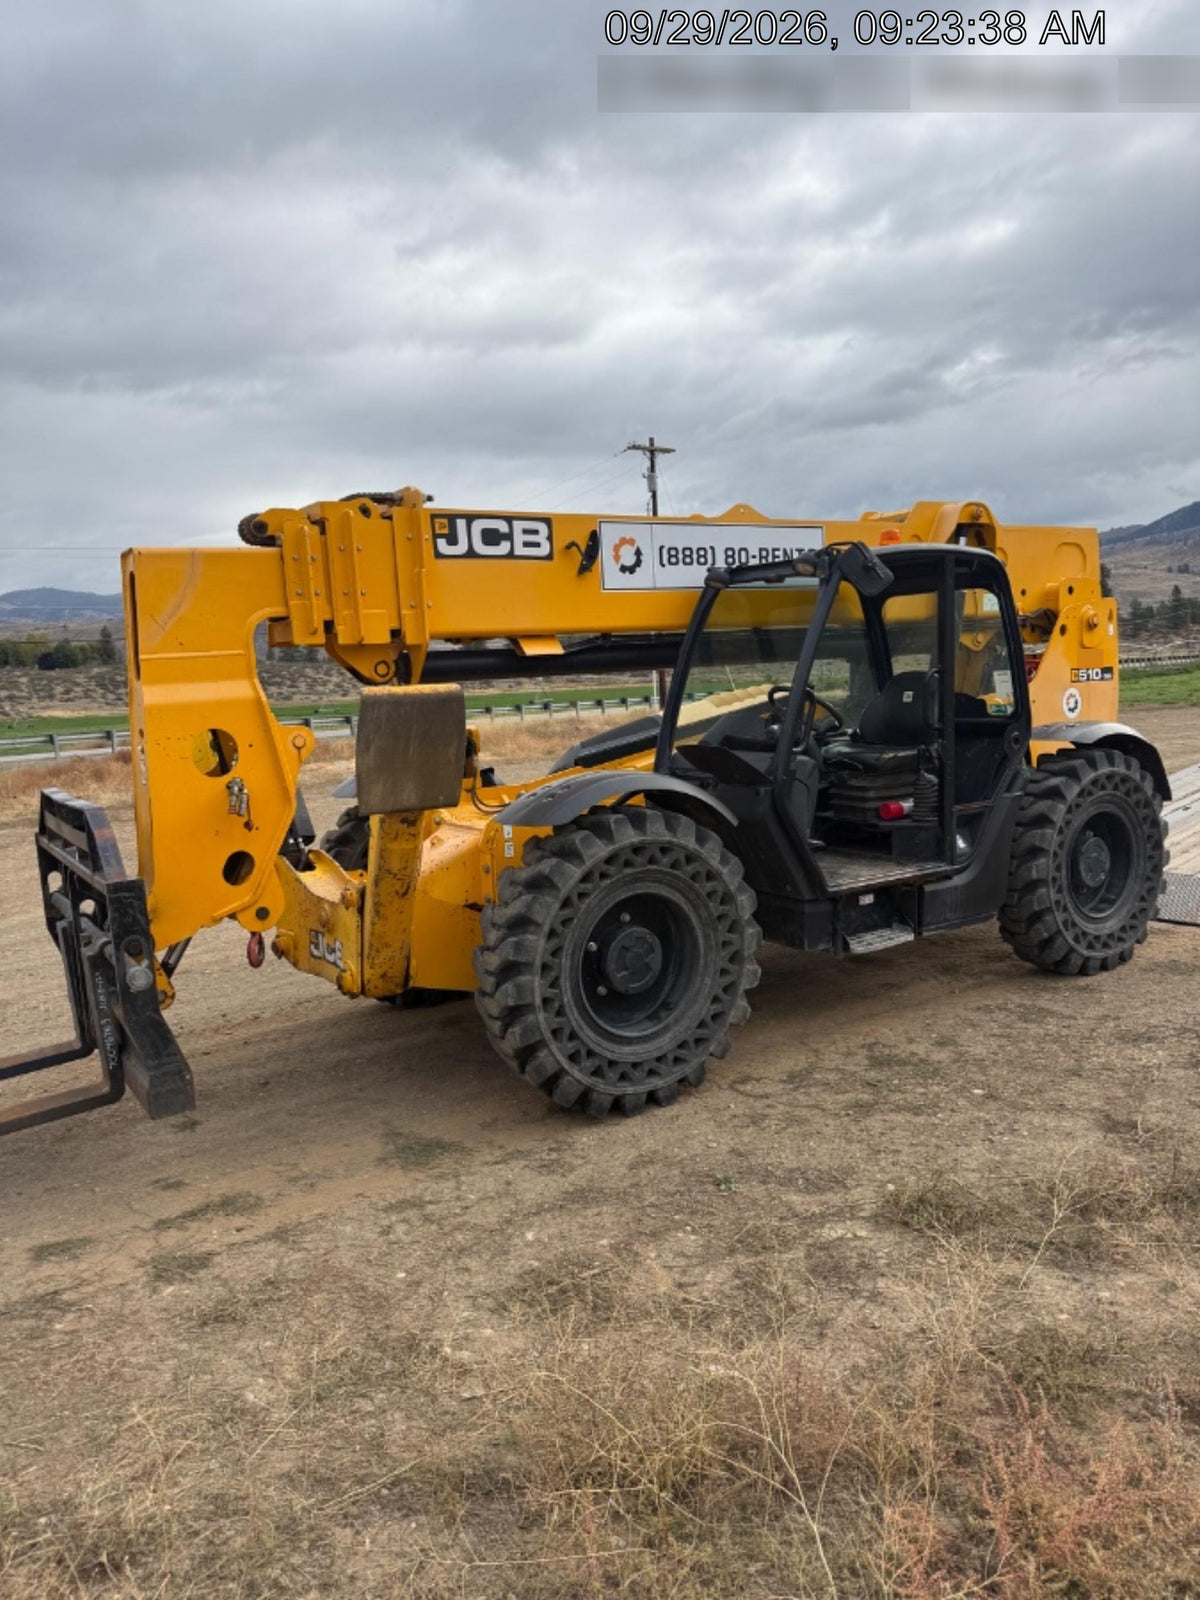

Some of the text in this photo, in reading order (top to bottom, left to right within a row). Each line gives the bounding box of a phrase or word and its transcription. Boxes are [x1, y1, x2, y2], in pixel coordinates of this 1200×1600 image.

[435, 517, 551, 557] JCB
[658, 545, 817, 567] (888) 80-RENT
